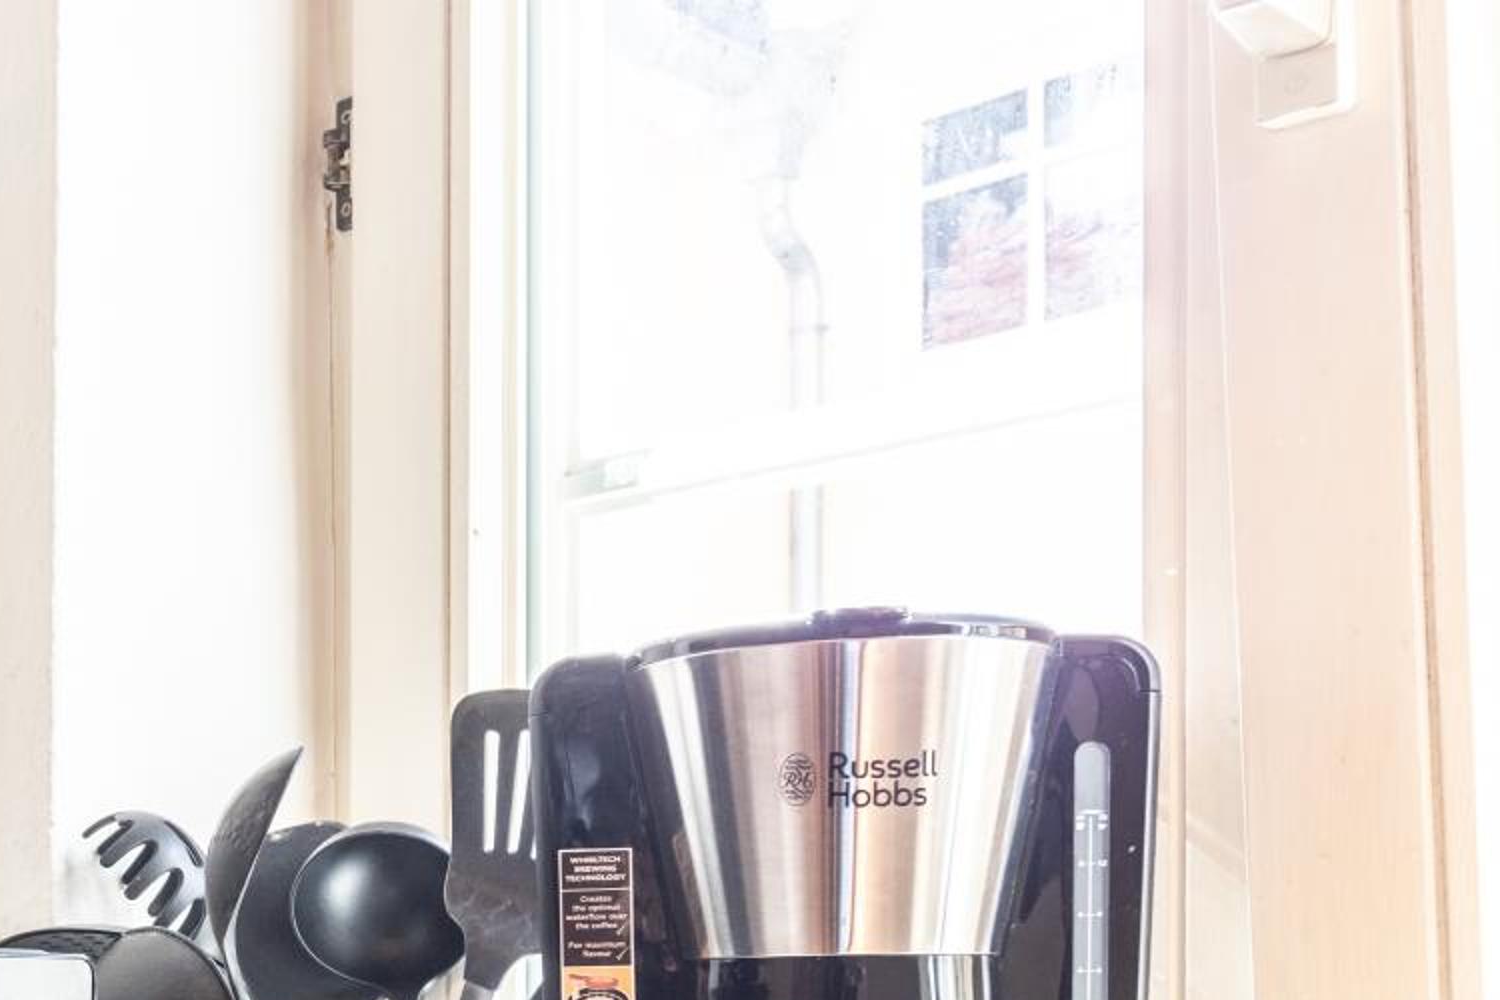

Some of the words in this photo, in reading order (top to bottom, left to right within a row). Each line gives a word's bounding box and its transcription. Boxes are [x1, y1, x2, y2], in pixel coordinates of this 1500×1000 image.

[828, 749, 937, 779] Russell
[828, 780, 928, 808] Hobbs
[564, 874, 627, 882] TECHNOLOGY
